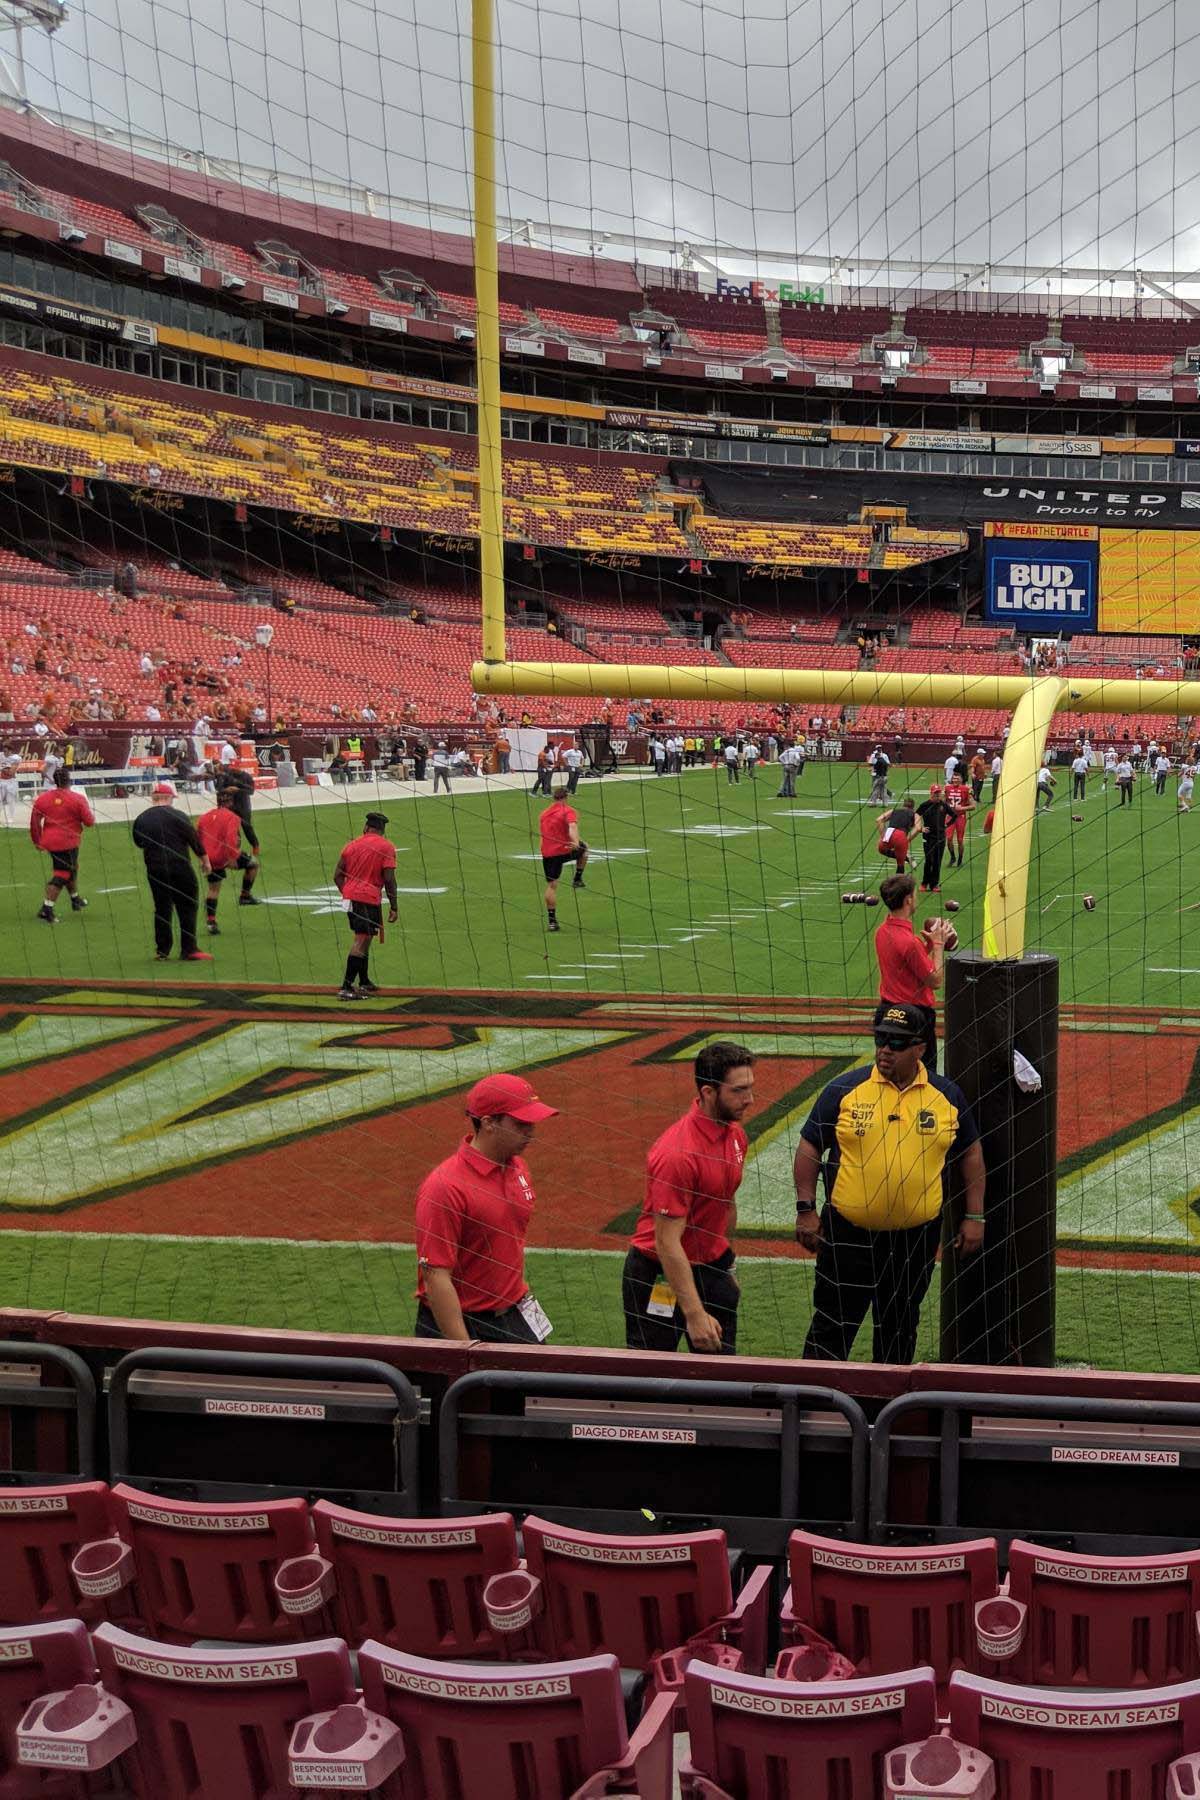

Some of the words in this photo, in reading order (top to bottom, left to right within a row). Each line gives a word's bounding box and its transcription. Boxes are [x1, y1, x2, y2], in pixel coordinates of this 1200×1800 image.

[717, 279, 825, 304] FedExField
[46, 305, 79, 321] OFFICIAL
[79, 314, 106, 328] MOBILE
[732, 429, 759, 438] SALUTE
[1074, 443, 1092, 452] sas
[983, 487, 1168, 505] UNITED
[1036, 505, 1099, 515] Proud
[1106, 506, 1126, 516] to
[1134, 507, 1160, 518] fly
[1009, 524, 1089, 537] #FEARTHETURTLE
[1010, 564, 1073, 588] BUD
[997, 586, 1082, 611] LIGHT
[806, 746, 842, 757] SAUTE
[887, 1009, 906, 1019] CSC
[207, 1402, 248, 1413] DIAGEO
[251, 1403, 289, 1415] DREAM
[292, 1406, 323, 1416] SEATS
[574, 1426, 617, 1438] DIAGEO
[620, 1429, 659, 1440] DREAM
[662, 1431, 694, 1441] SEATS
[1054, 1450, 1097, 1460] DIAGEO
[1101, 1451, 1140, 1462] DREAM
[1144, 1453, 1176, 1463] SEATS
[22, 1499, 63, 1510] SEATS
[129, 1504, 169, 1523] DIAGEO
[173, 1514, 219, 1528] DREAM
[224, 1516, 265, 1528] SEATS
[333, 1522, 375, 1541] DIAGEO
[379, 1532, 426, 1544] DREAM
[431, 1531, 472, 1543] SEATS
[544, 1537, 590, 1557] DIAGEO
[593, 1549, 641, 1561] DREAM
[646, 1548, 687, 1560] SEATS
[814, 1551, 863, 1568] DIAGEO
[867, 1560, 912, 1571] DREAM
[917, 1558, 960, 1569] SEATS
[1037, 1561, 1087, 1579] DIAGEO
[1091, 1572, 1140, 1582] DREAM
[1146, 1568, 1184, 1581] SEATS
[0, 1642, 28, 1656] ATS
[115, 1649, 169, 1674] DIAGEO
[173, 1663, 234, 1677] DREAM
[240, 1661, 293, 1676] SEATS
[384, 1667, 441, 1691] DIAGEO
[446, 1682, 509, 1695] DREAM
[515, 1678, 567, 1695] SEATS
[714, 1687, 776, 1710] DIAGEO
[781, 1698, 835, 1713] DREAM
[841, 1692, 901, 1710] SEATS
[984, 1698, 1049, 1721] DIAGEO
[1056, 1711, 1119, 1725] DREAM
[1126, 1705, 1175, 1721] SEATS
[21, 1739, 84, 1754] RESPONSIBILITY
[37, 1752, 59, 1761] TEAM
[294, 1765, 362, 1773] RESPONSIBILITY
